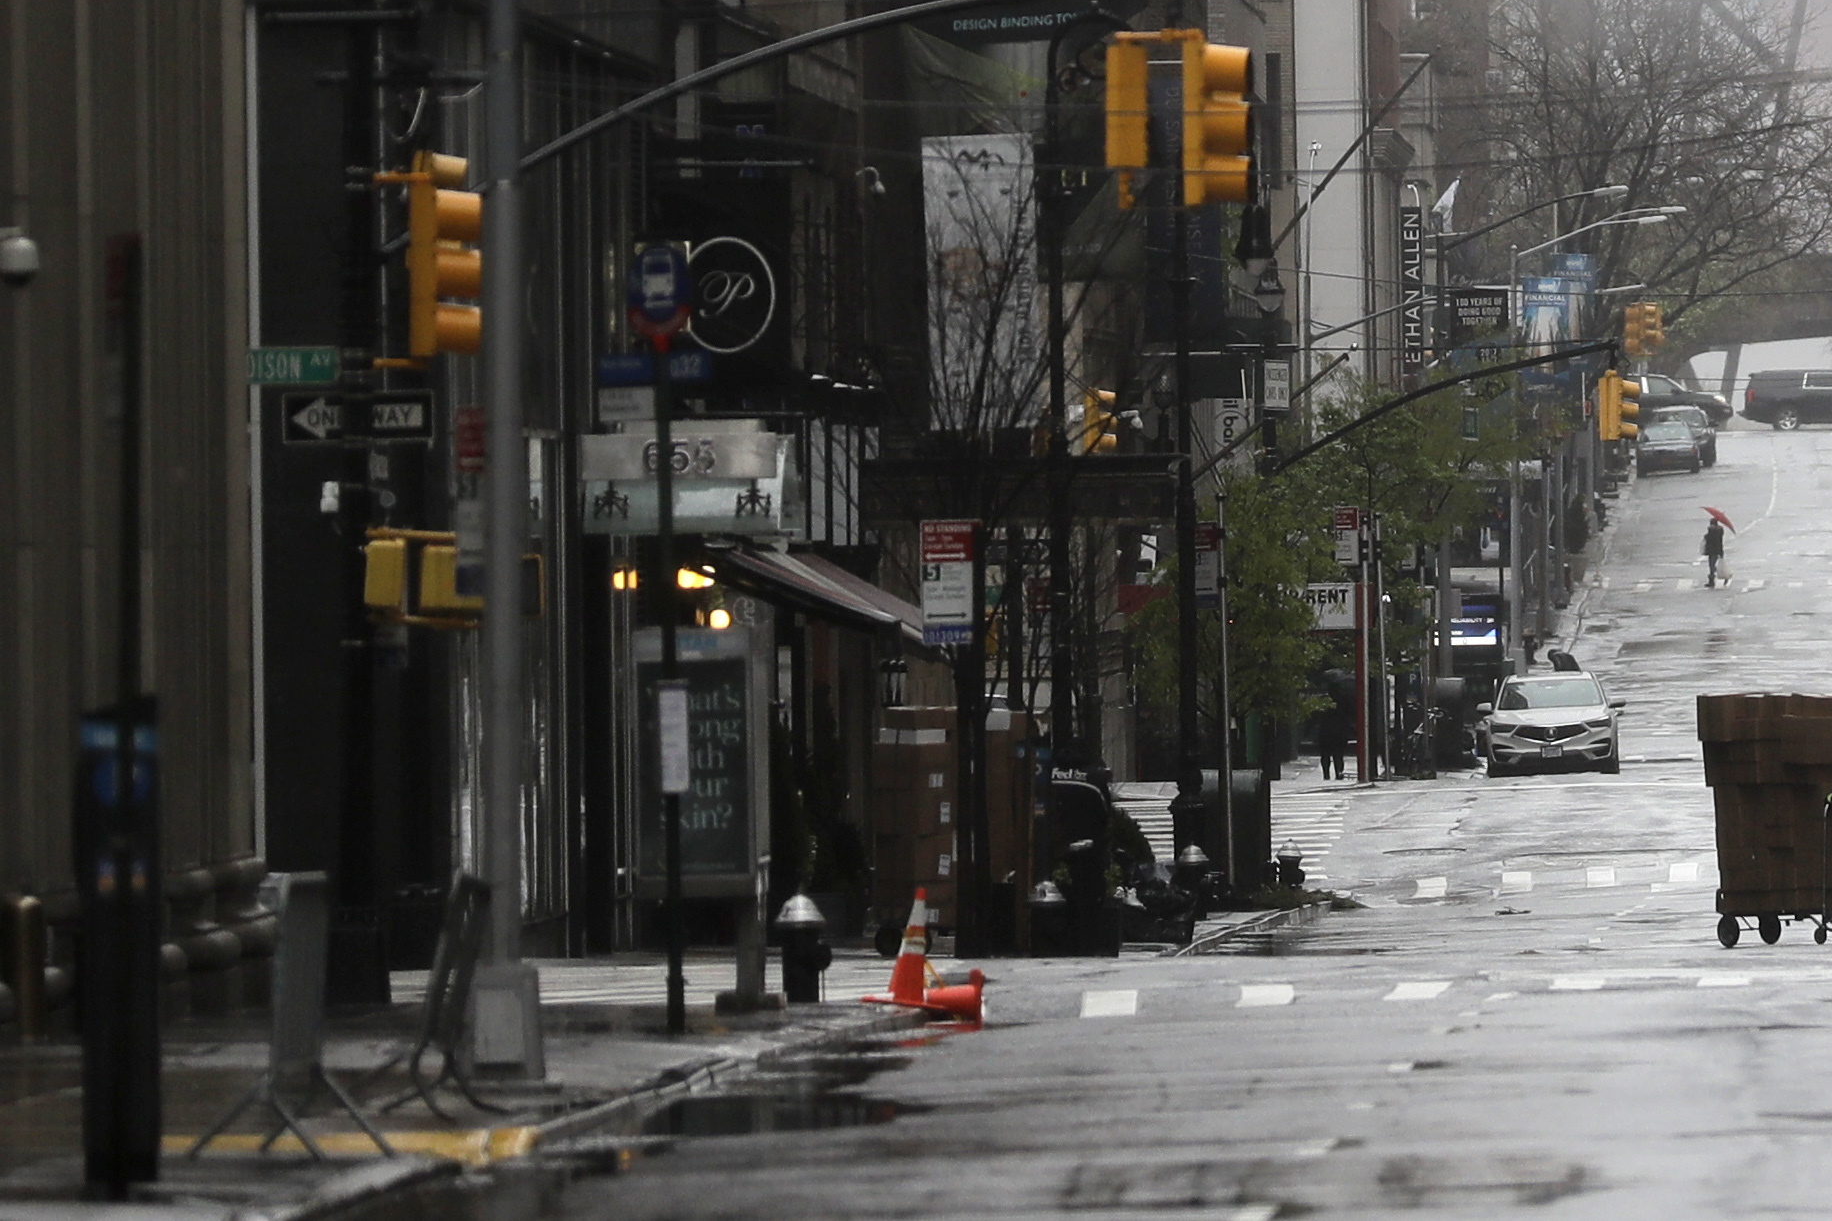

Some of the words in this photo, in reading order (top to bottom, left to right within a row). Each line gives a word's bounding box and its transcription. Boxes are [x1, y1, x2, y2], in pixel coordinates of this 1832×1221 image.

[953, 18, 997, 31] DESIGN
[1000, 15, 1052, 28] BINDING
[1403, 213, 1420, 280] ALLEN
[1470, 297, 1493, 306] YEARS
[1494, 297, 1503, 306] OF
[1458, 307, 1480, 317] DOING
[1481, 307, 1502, 316] GOOD
[1403, 290, 1421, 363] ETHAN
[310, 355, 331, 366] AV
[924, 524, 935, 534] NO
[936, 523, 972, 534] STANDING
[1306, 588, 1348, 604] RENT
